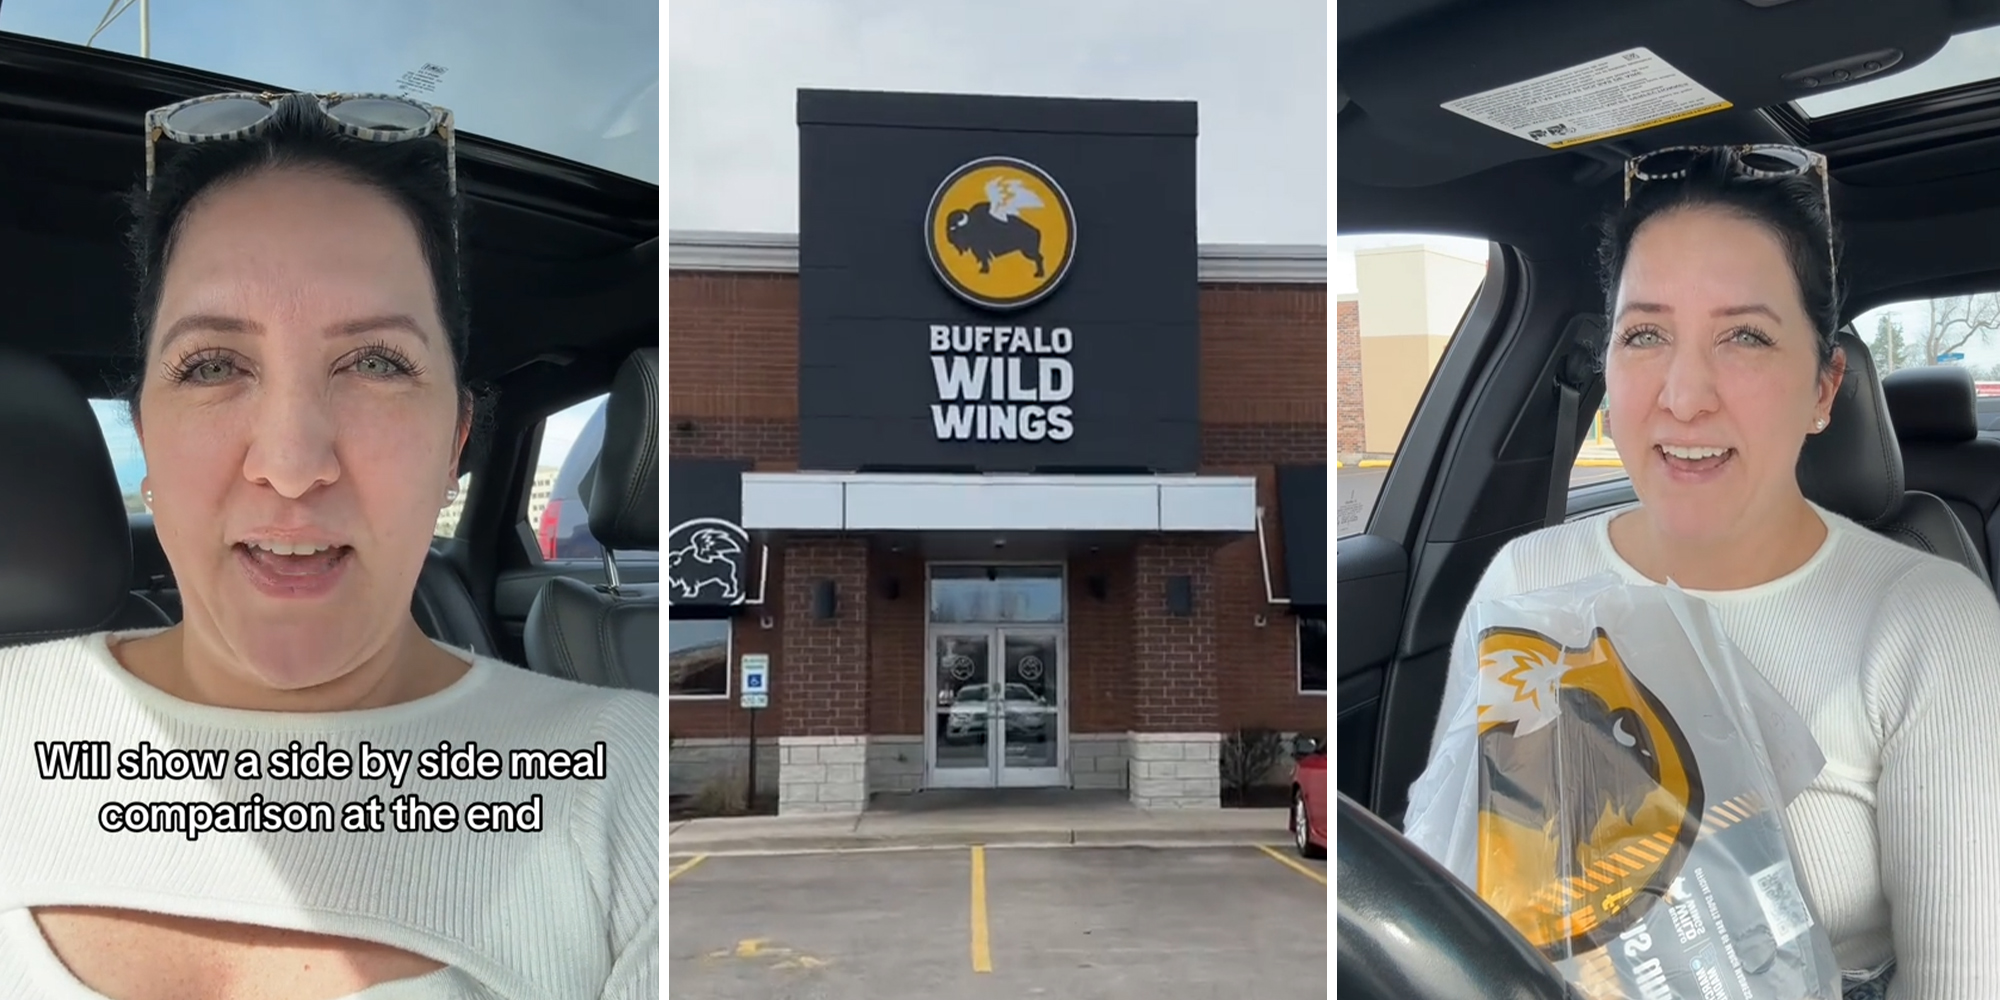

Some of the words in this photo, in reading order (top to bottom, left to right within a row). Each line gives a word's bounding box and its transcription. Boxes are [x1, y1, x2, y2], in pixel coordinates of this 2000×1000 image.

[930, 325, 1073, 354] BUFFALO
[931, 356, 1073, 401] WILD
[931, 405, 1073, 440] WINGS
